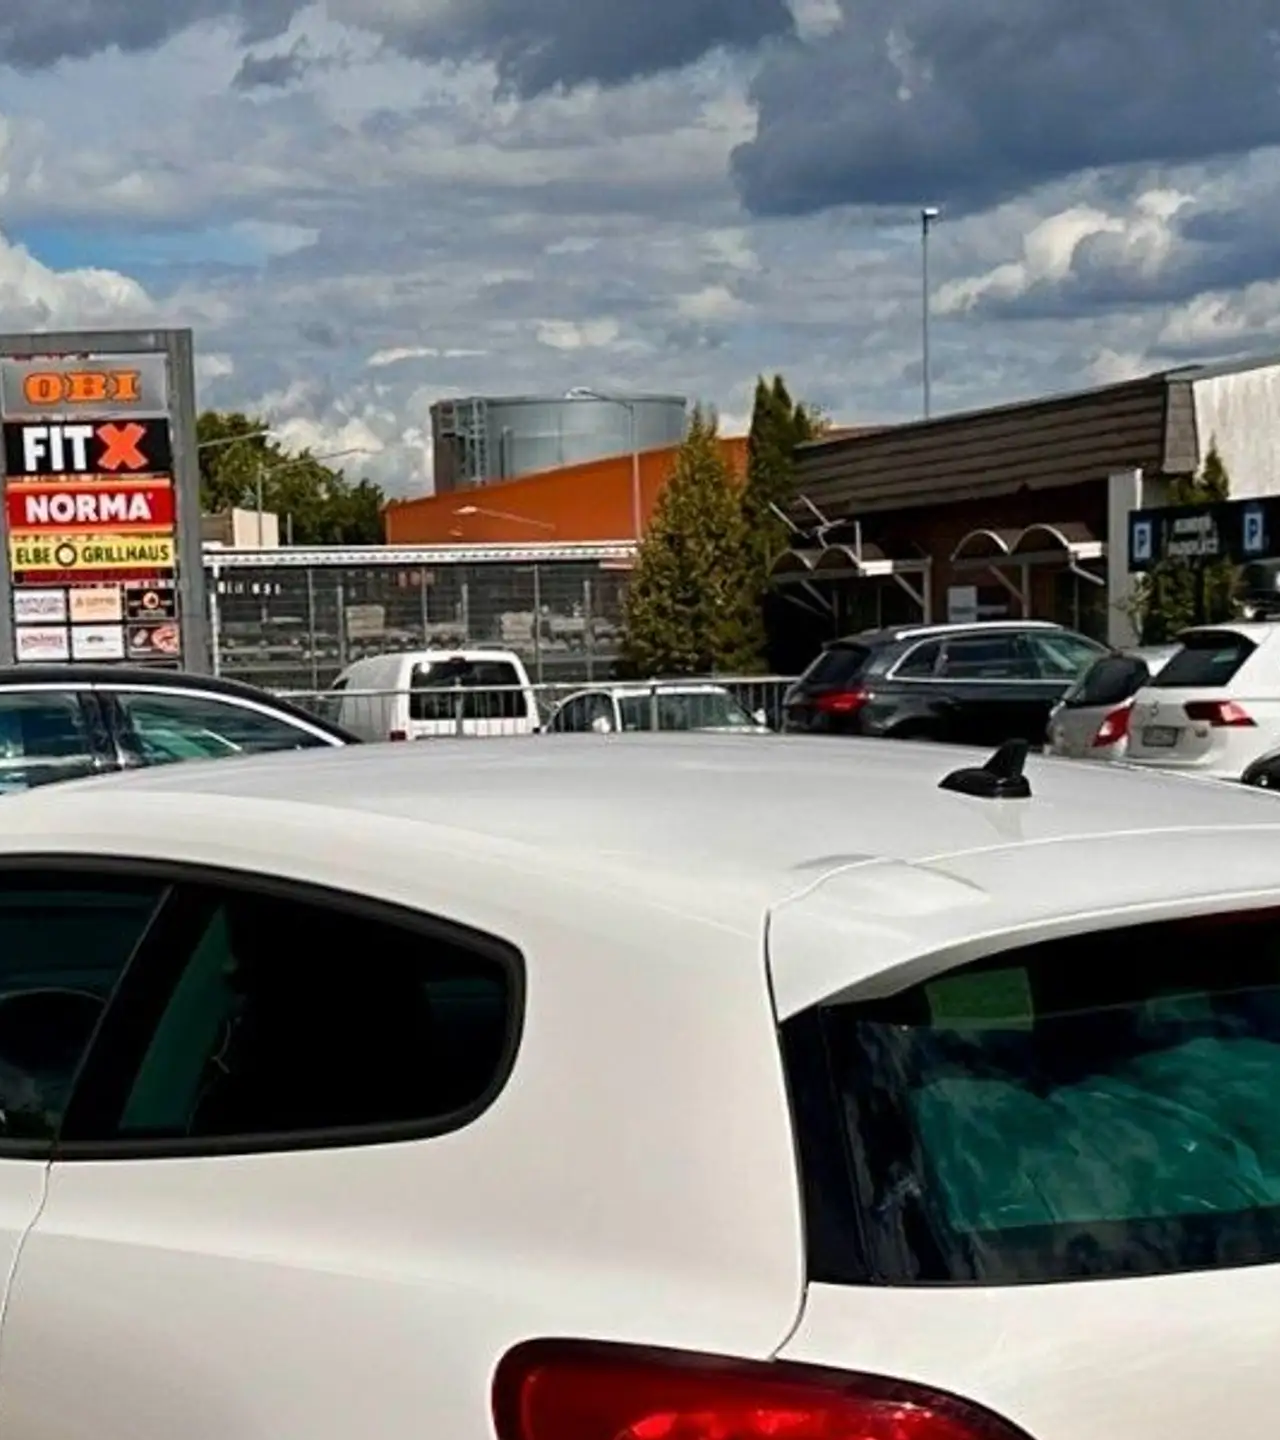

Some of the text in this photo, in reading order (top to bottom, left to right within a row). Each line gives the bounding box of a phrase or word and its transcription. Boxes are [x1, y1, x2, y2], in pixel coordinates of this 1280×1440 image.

[23, 370, 142, 406] OBI
[24, 491, 152, 524] NORMA
[14, 543, 170, 566] ELBE GRILLHAUS
